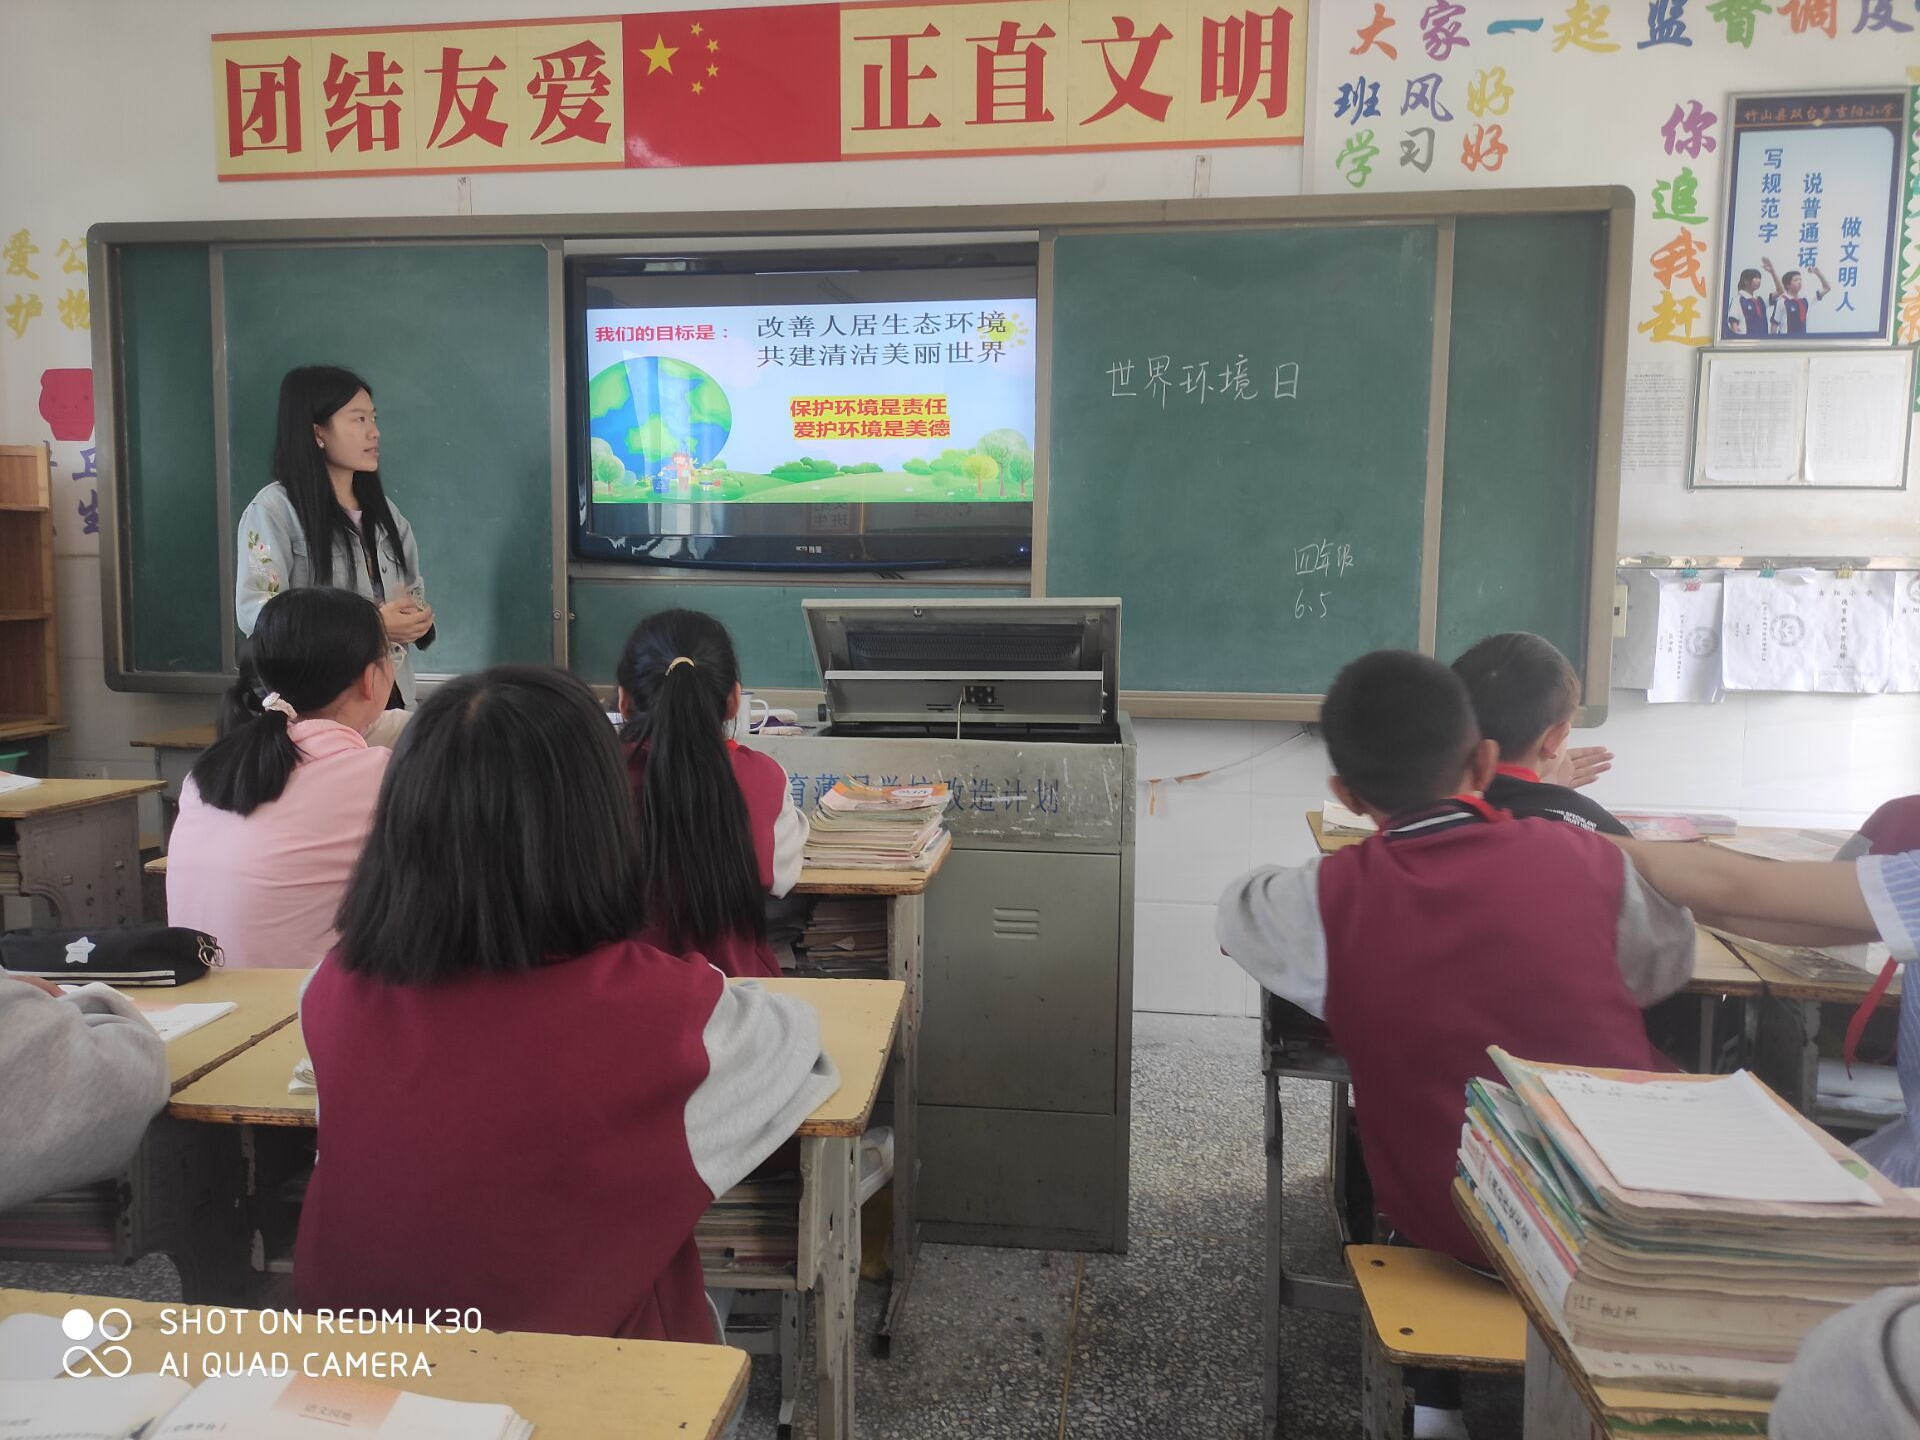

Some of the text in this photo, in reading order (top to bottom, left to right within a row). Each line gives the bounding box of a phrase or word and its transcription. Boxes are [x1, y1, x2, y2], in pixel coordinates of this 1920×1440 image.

[1349, 0, 1920, 62] 大家一起监督调度
[225, 39, 612, 158] 团结友爱
[851, 6, 1294, 132] 正直文明
[1334, 67, 1514, 125] 班风好
[1335, 124, 1509, 188] 学习好
[1637, 100, 1718, 346] 你追我赶
[1757, 148, 1784, 244] 写规范字
[1797, 172, 1823, 269] 说普通话
[1836, 216, 1862, 312] 做文明人
[595, 323, 730, 343] 我们的目标是：
[757, 310, 1007, 340] 改善人居生态环境
[757, 341, 1007, 368] 共建清洁美丽世界
[790, 398, 948, 418] 保护环境是责任
[1106, 354, 1299, 410] 世界环境日
[794, 419, 951, 438] 爱护环境是美德
[1294, 538, 1354, 577] 四年级
